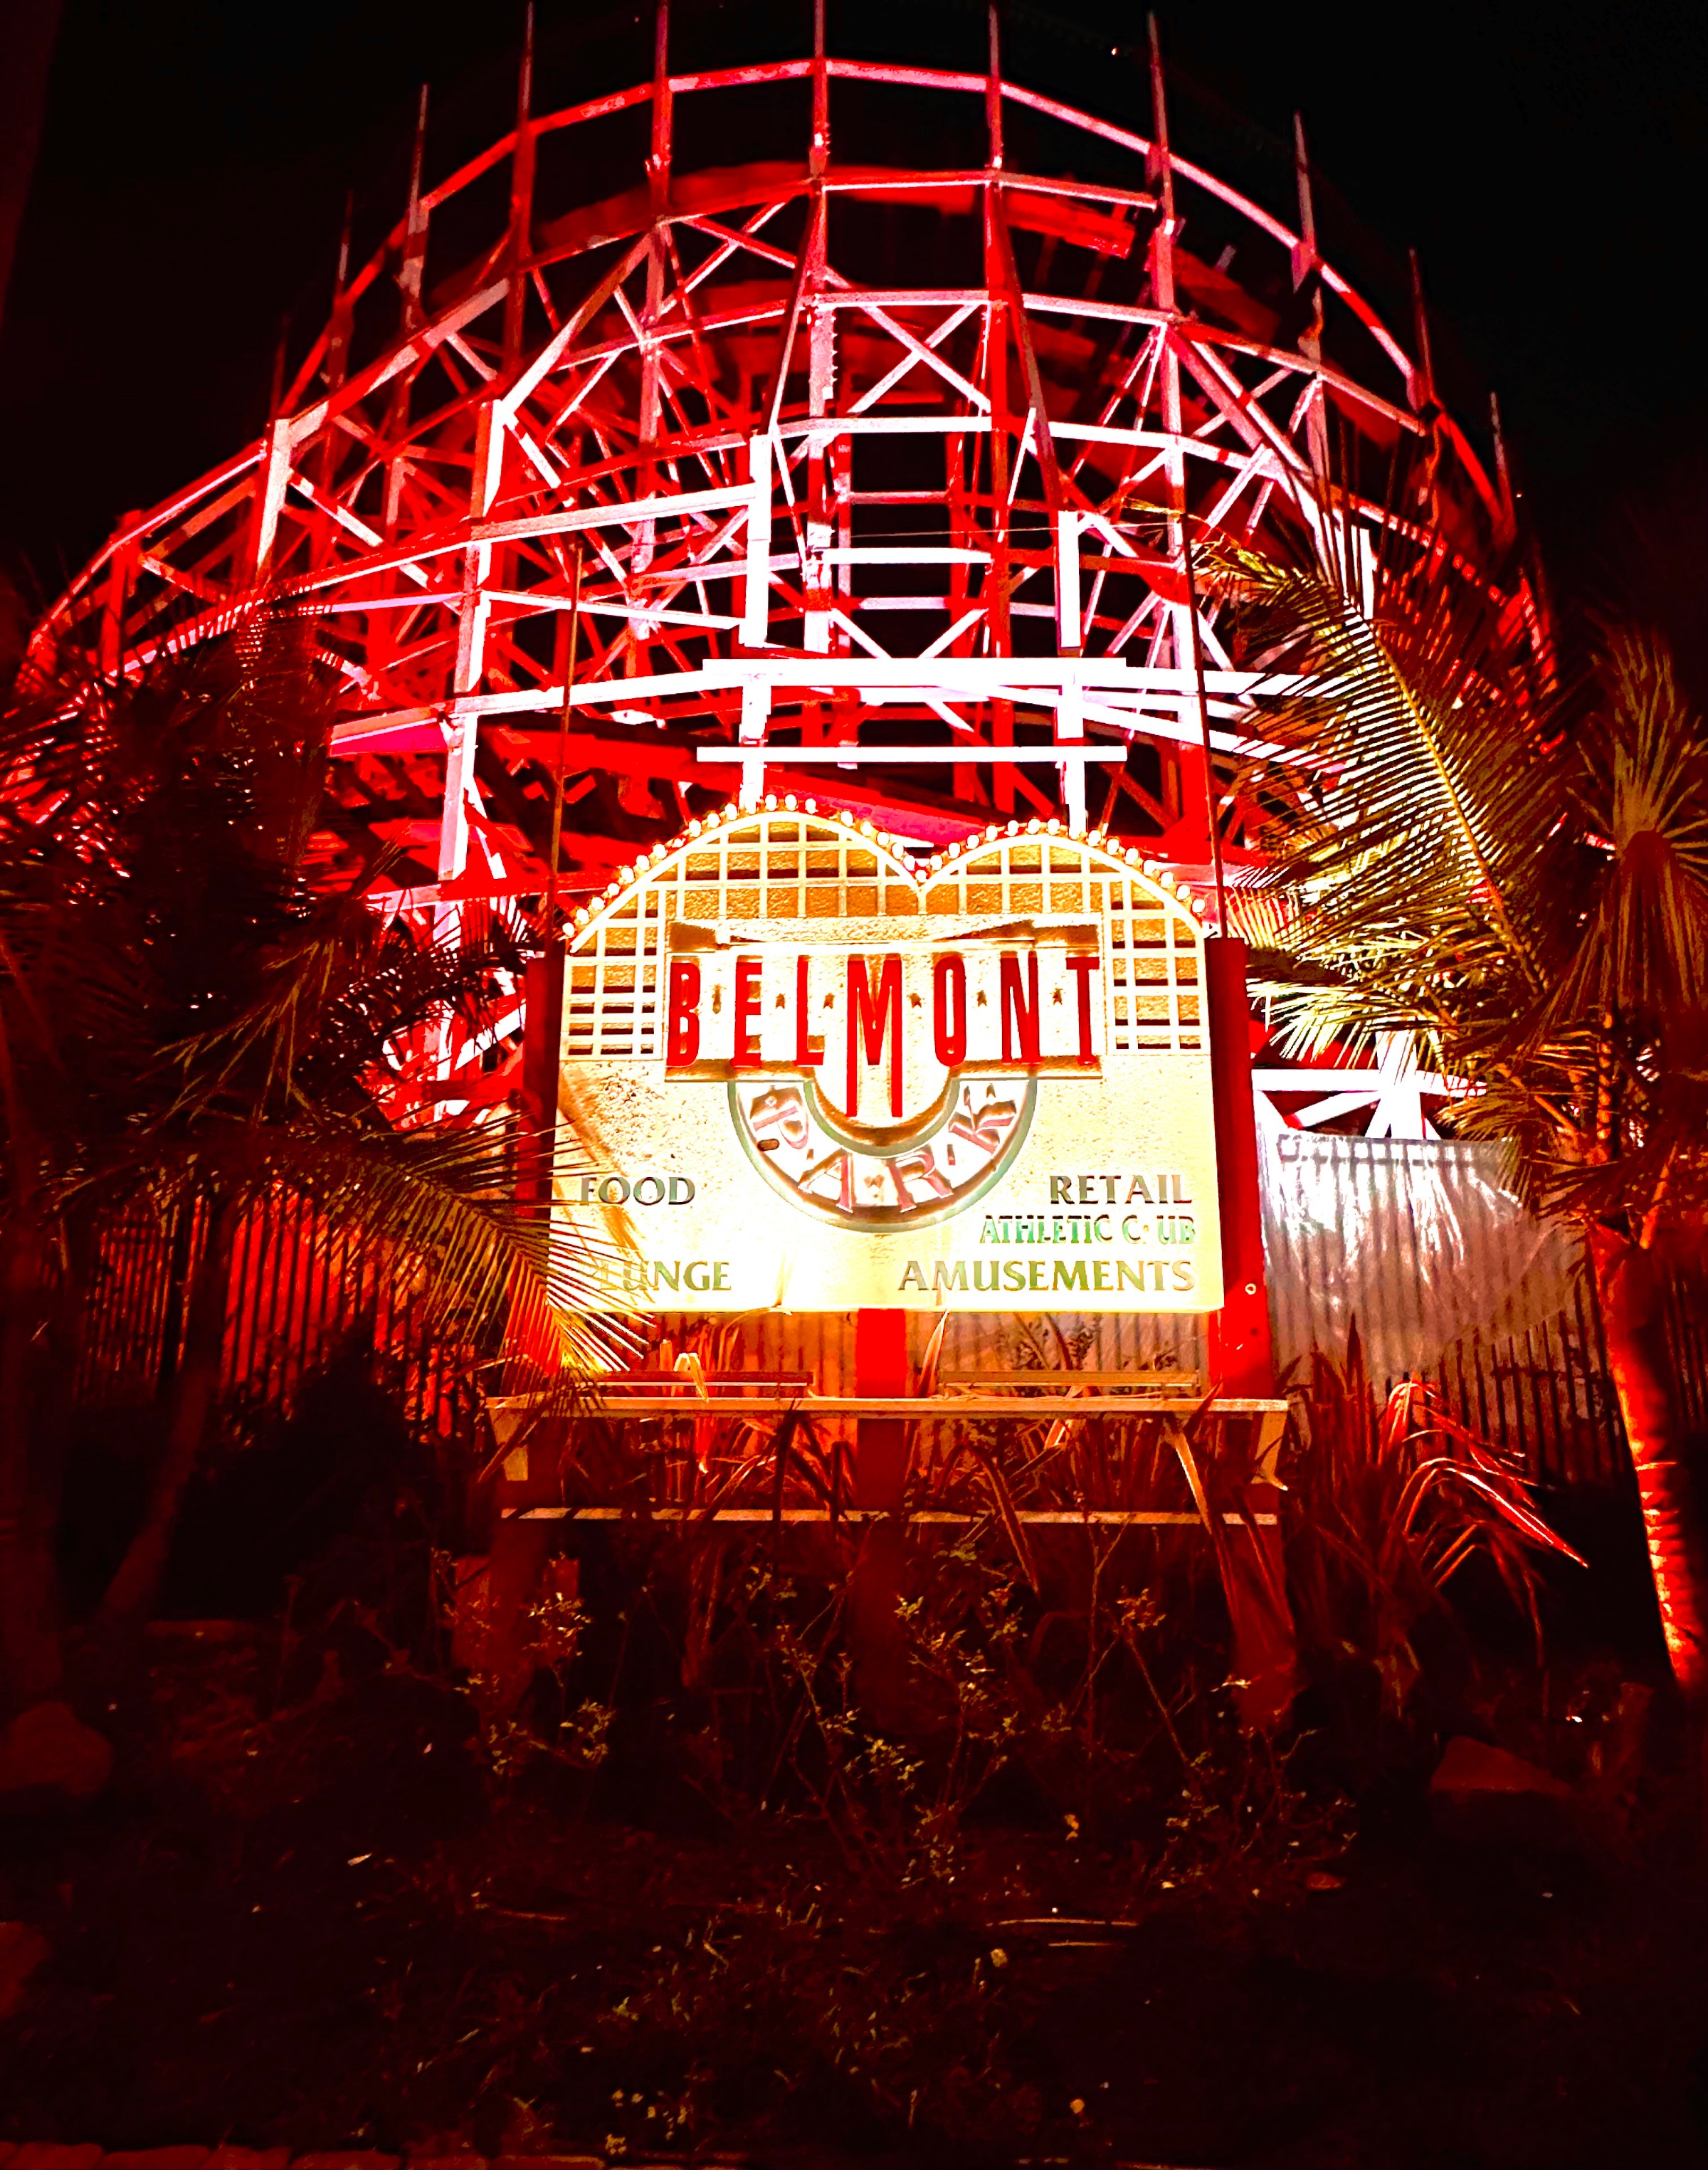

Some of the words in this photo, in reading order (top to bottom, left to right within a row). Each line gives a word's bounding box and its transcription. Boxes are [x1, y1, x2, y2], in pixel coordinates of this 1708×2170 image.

[666, 953, 1100, 1117] BELMONT
[750, 1086, 1017, 1213] PARK
[581, 1176, 695, 1206] FOOD
[1049, 1174, 1193, 1204] RETAIL
[979, 1214, 1113, 1244] ATHLETIC
[1122, 1214, 1196, 1245] CUB
[579, 1260, 732, 1292] LUNGE
[897, 1260, 1196, 1291] AMUSEMENTS
